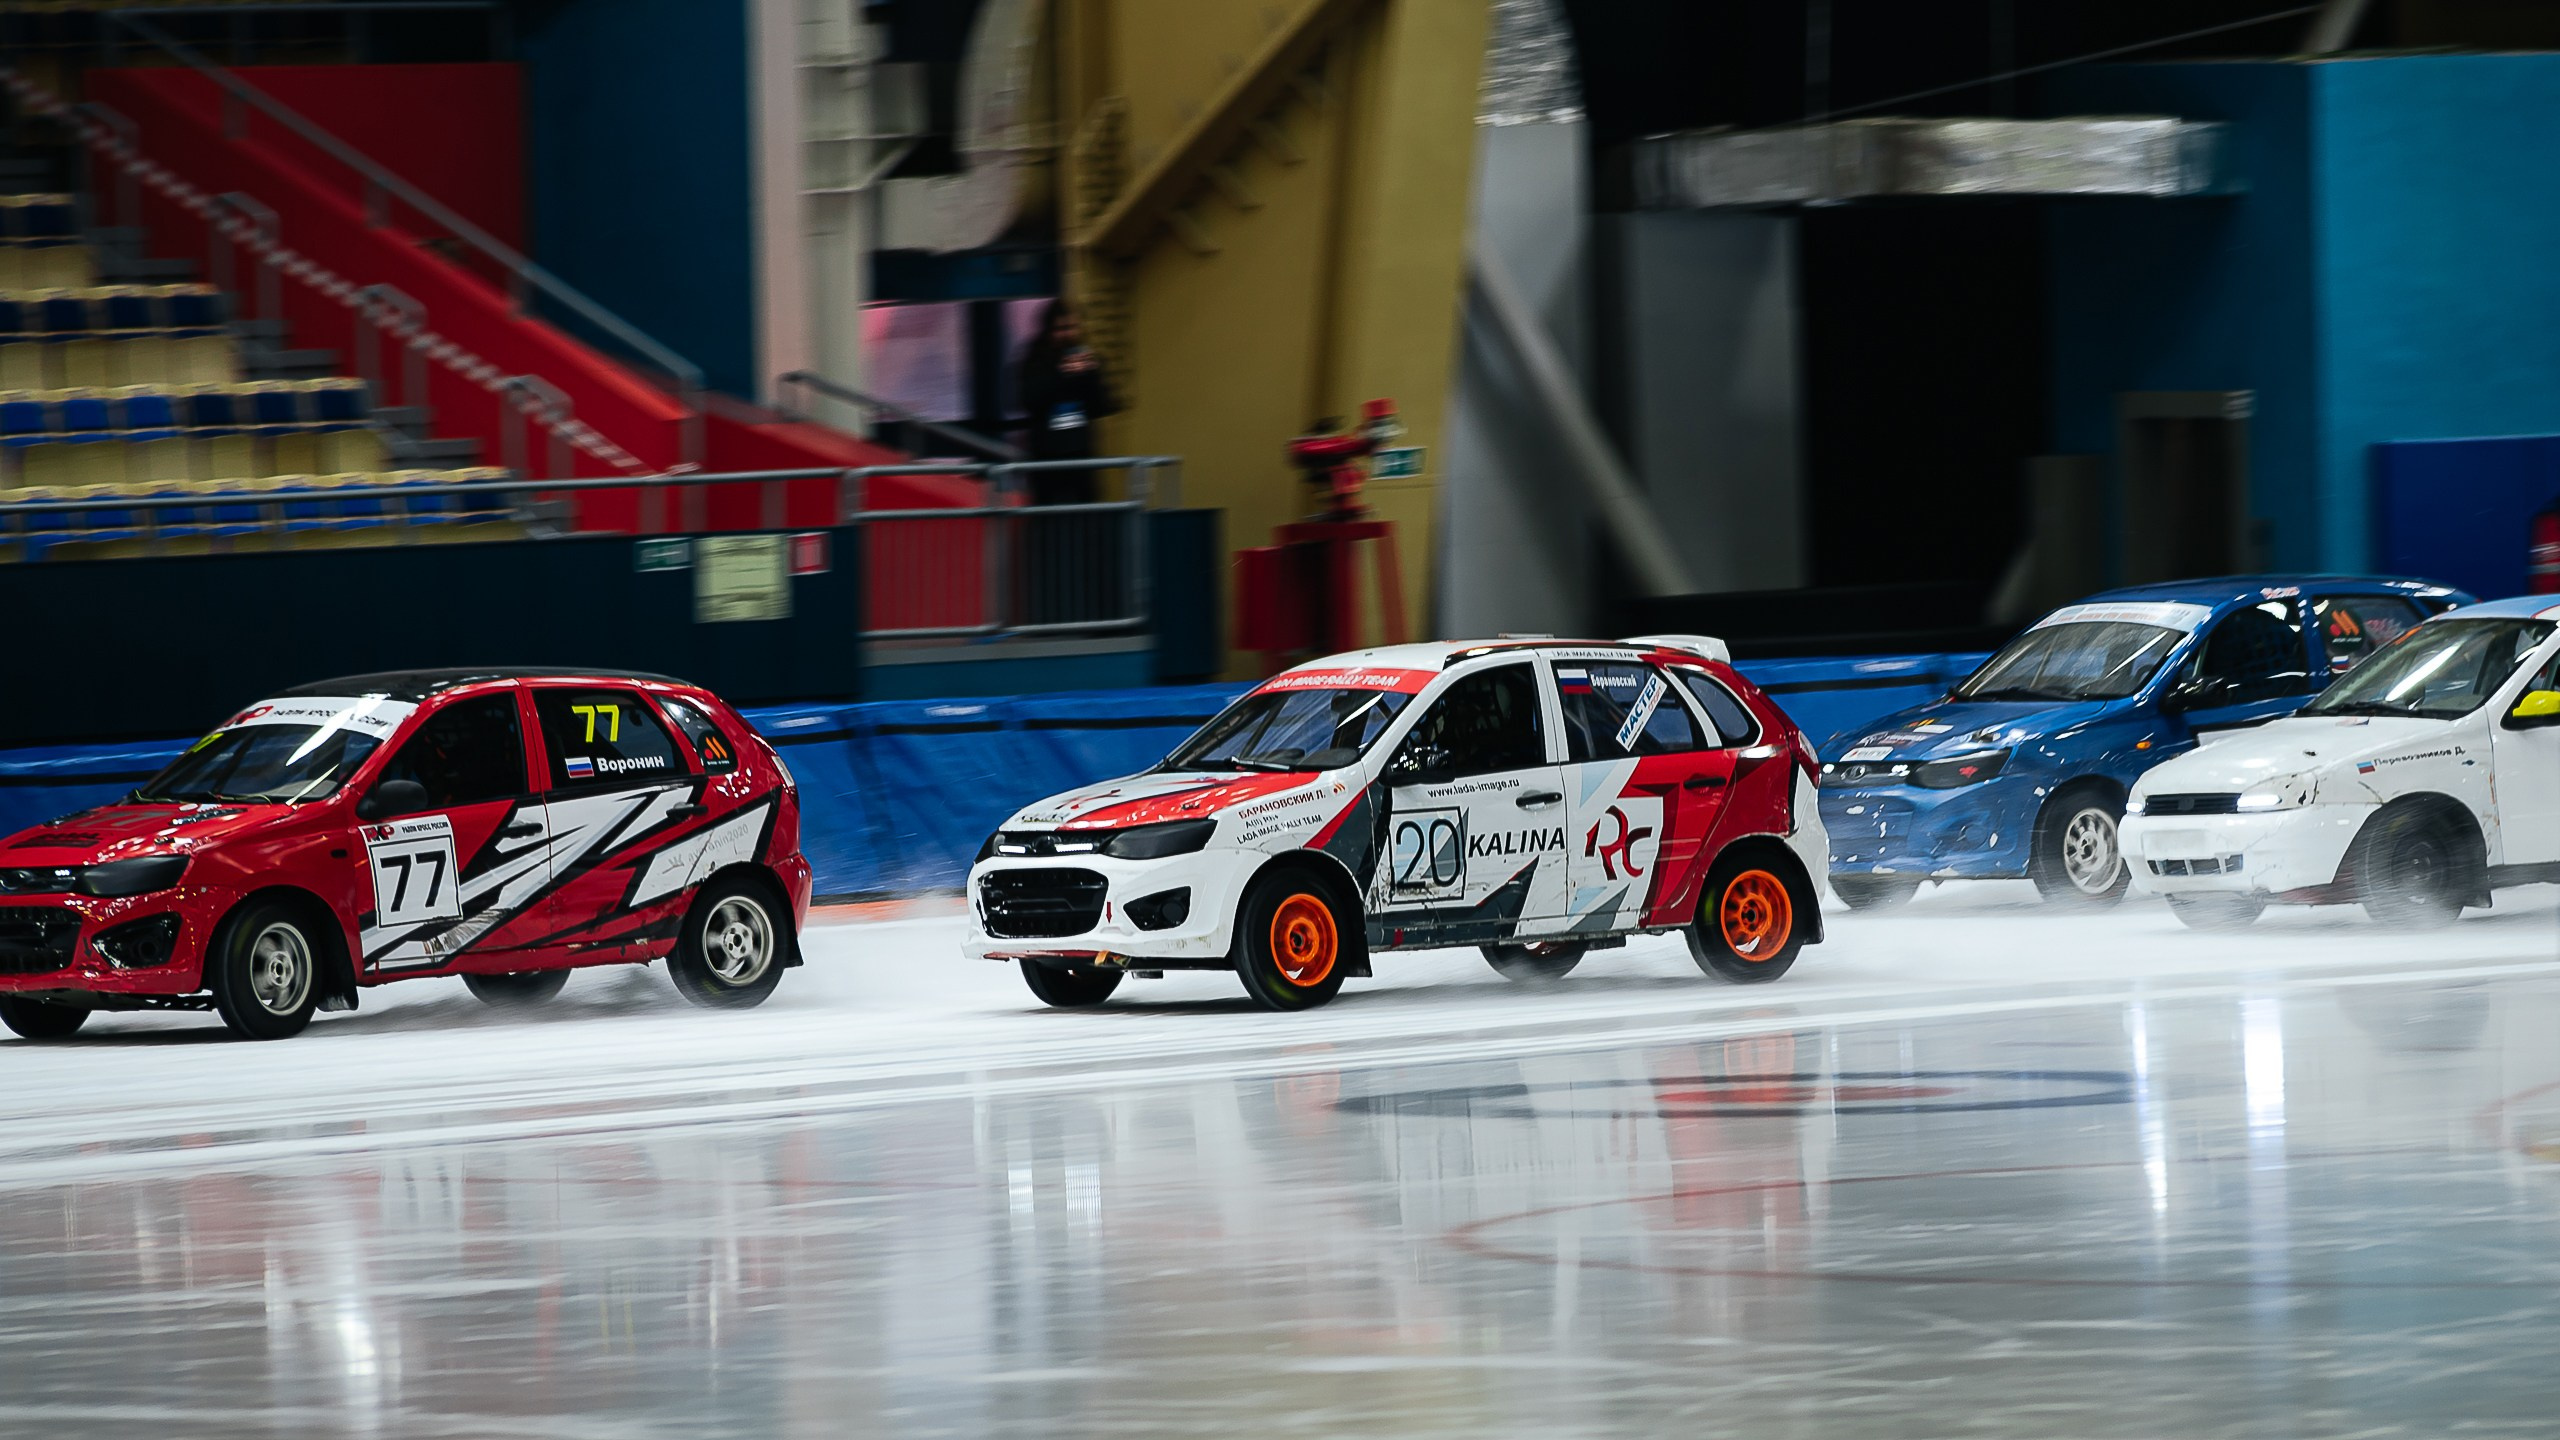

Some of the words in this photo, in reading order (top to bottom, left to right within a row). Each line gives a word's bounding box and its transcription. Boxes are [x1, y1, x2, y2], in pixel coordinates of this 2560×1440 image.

[571, 704, 620, 743] 77
[1619, 676, 1658, 745] МАСТЕР
[596, 755, 665, 774] Воронин
[1427, 777, 1520, 798] www.lada-image.ru
[1395, 818, 1461, 888] 20
[1468, 827, 1566, 858] KALINA
[379, 849, 447, 913] 77
